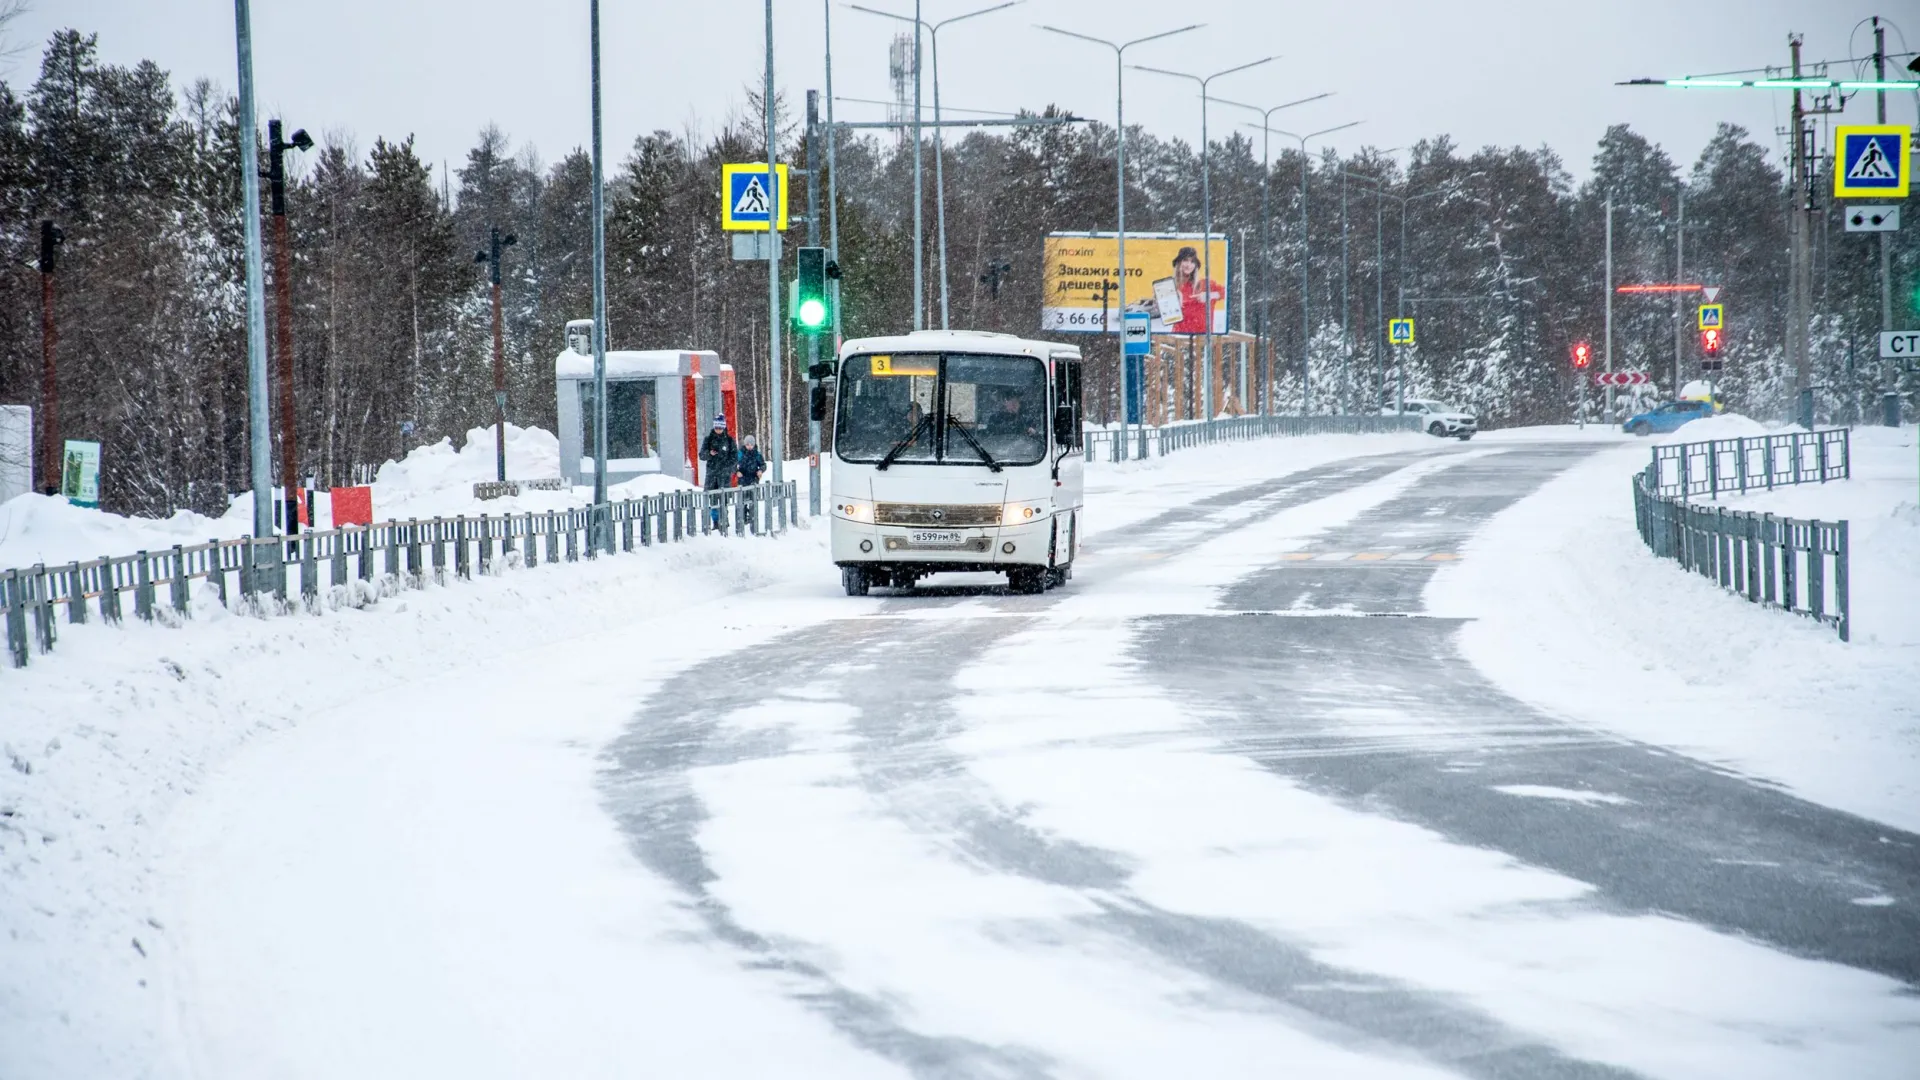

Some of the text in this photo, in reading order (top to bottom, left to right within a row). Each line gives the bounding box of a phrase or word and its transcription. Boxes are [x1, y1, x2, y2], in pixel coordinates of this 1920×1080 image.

[1058, 263, 1109, 277] Закажи
[1058, 281, 1119, 292] дешев
[877, 360, 885, 370] 3
